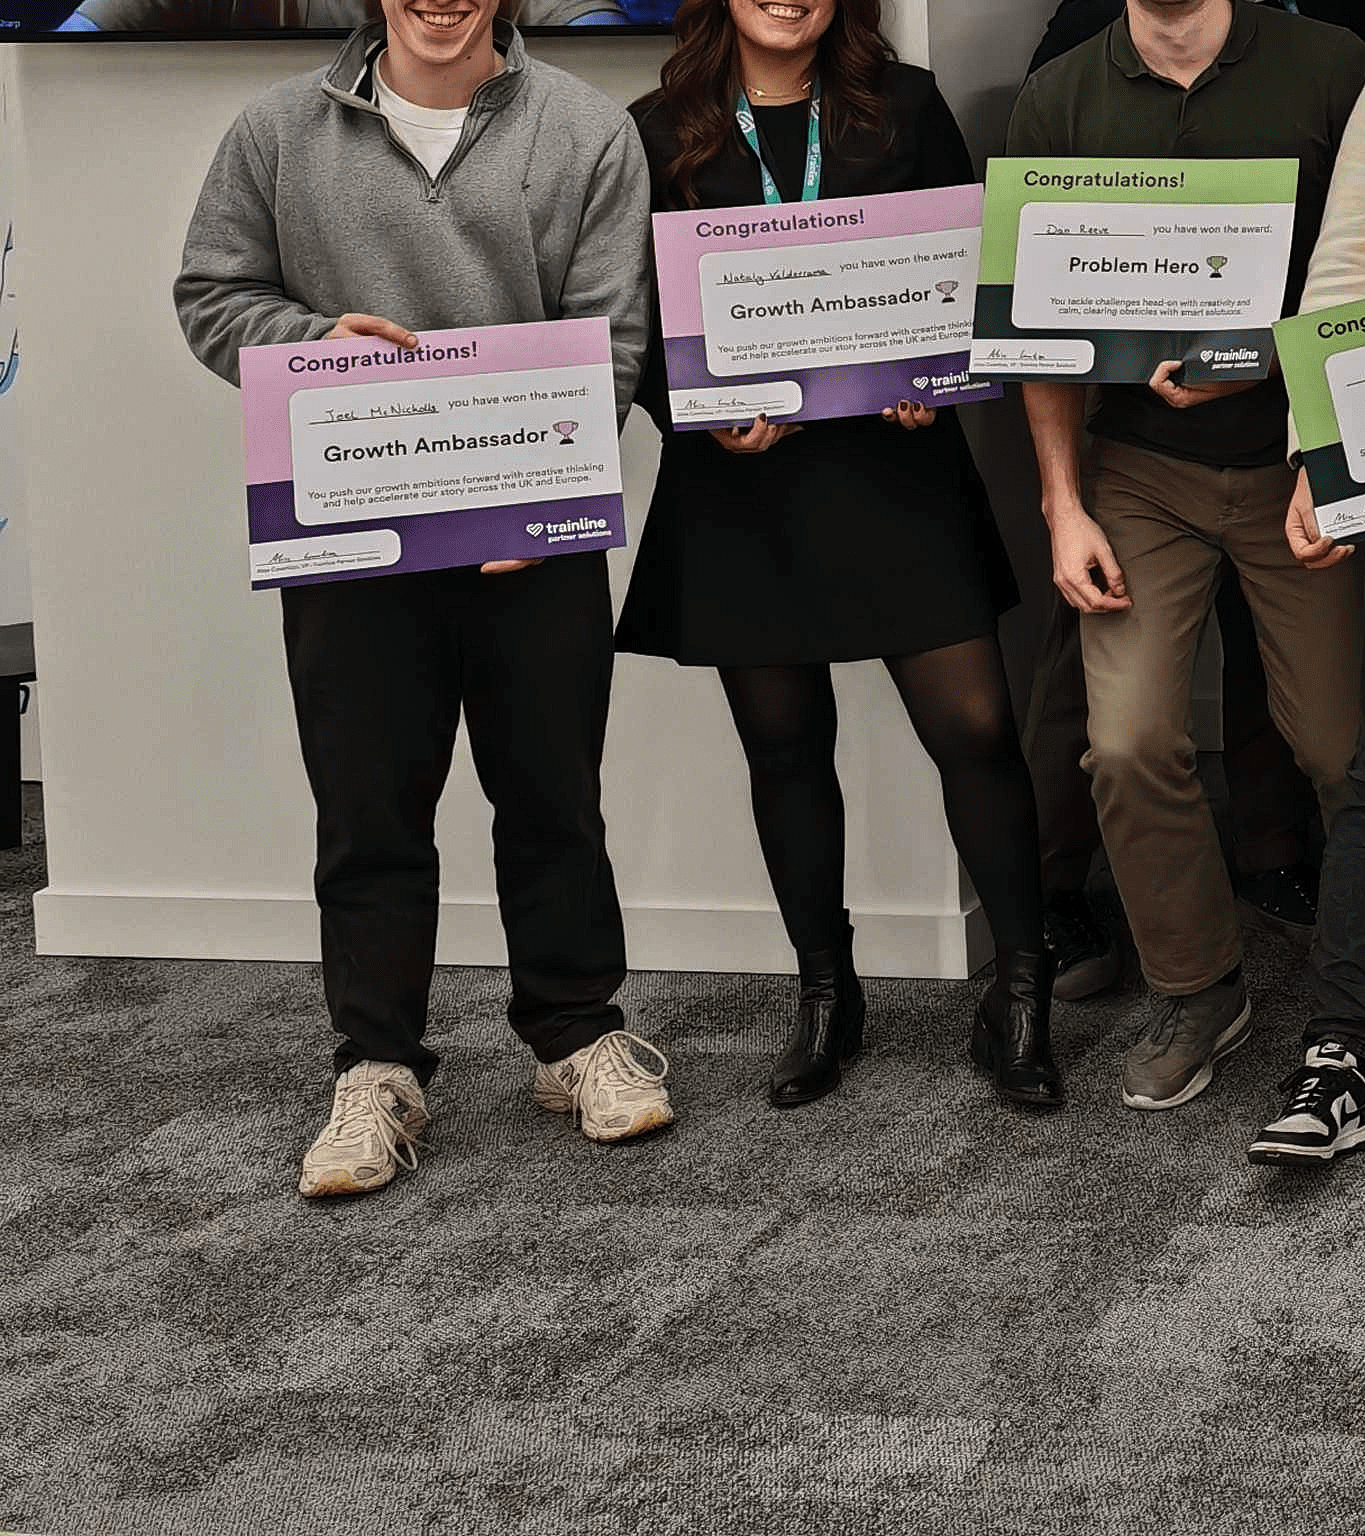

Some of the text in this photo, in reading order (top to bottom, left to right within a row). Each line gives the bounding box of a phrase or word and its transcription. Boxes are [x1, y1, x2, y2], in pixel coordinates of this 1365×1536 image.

[1023, 170, 1185, 191] Congratulations!
[695, 208, 865, 239] Congratulations!
[1047, 224, 1070, 234] Dan
[1152, 223, 1273, 236] you have won the award:
[839, 247, 968, 273] you have won the award:
[1069, 256, 1200, 274] Problem Hero
[730, 287, 932, 320] Growth Ambassador
[287, 341, 477, 374] Congratulations!
[1214, 348, 1259, 362] trainline
[930, 370, 970, 387] trainli
[447, 386, 589, 411] you have won the award:
[323, 427, 549, 463] Growth Ambassador
[545, 517, 607, 534] trainline
